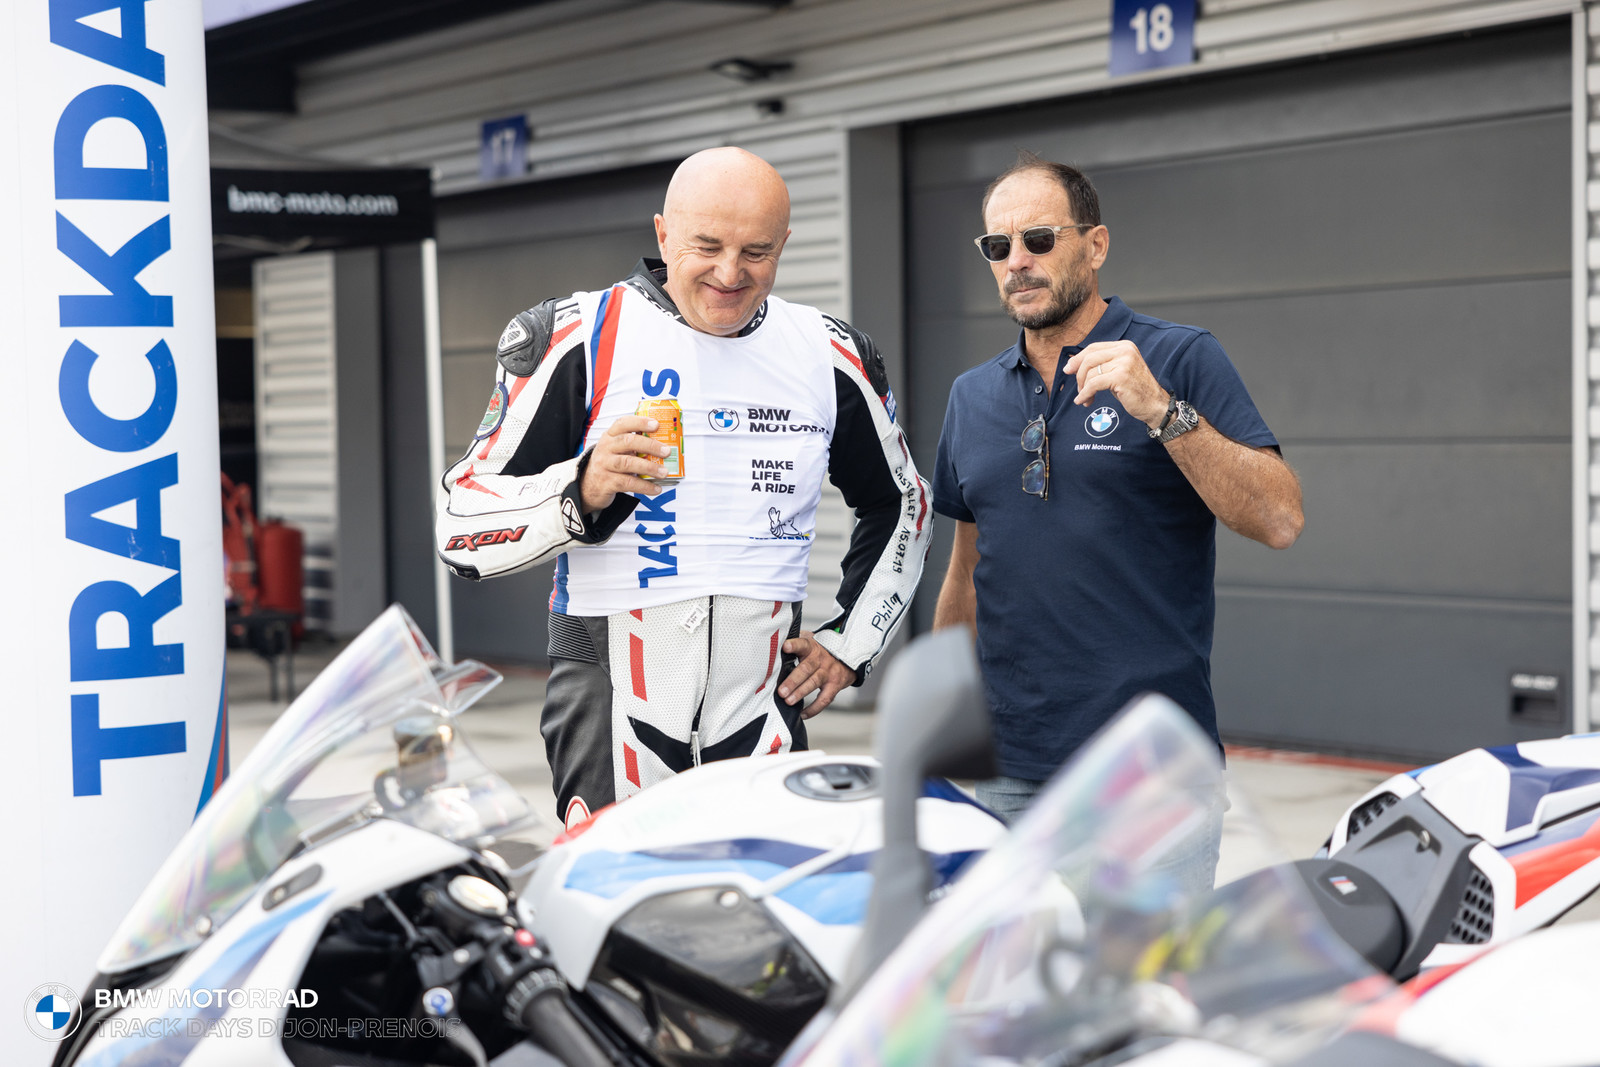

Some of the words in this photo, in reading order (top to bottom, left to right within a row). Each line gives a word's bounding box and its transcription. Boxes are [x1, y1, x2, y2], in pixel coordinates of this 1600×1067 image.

[1129, 3, 1174, 54] 18
[492, 128, 516, 166] 17
[227, 185, 398, 216] bmc-moto.com
[747, 408, 791, 421] BMW
[1074, 443, 1091, 451] BMW
[1091, 443, 1122, 452] Motorrad
[751, 459, 794, 470] MAKE
[752, 471, 781, 481] LIFE
[751, 482, 761, 492] A
[765, 483, 796, 494] RIDE
[895, 466, 916, 520] CASTELLET
